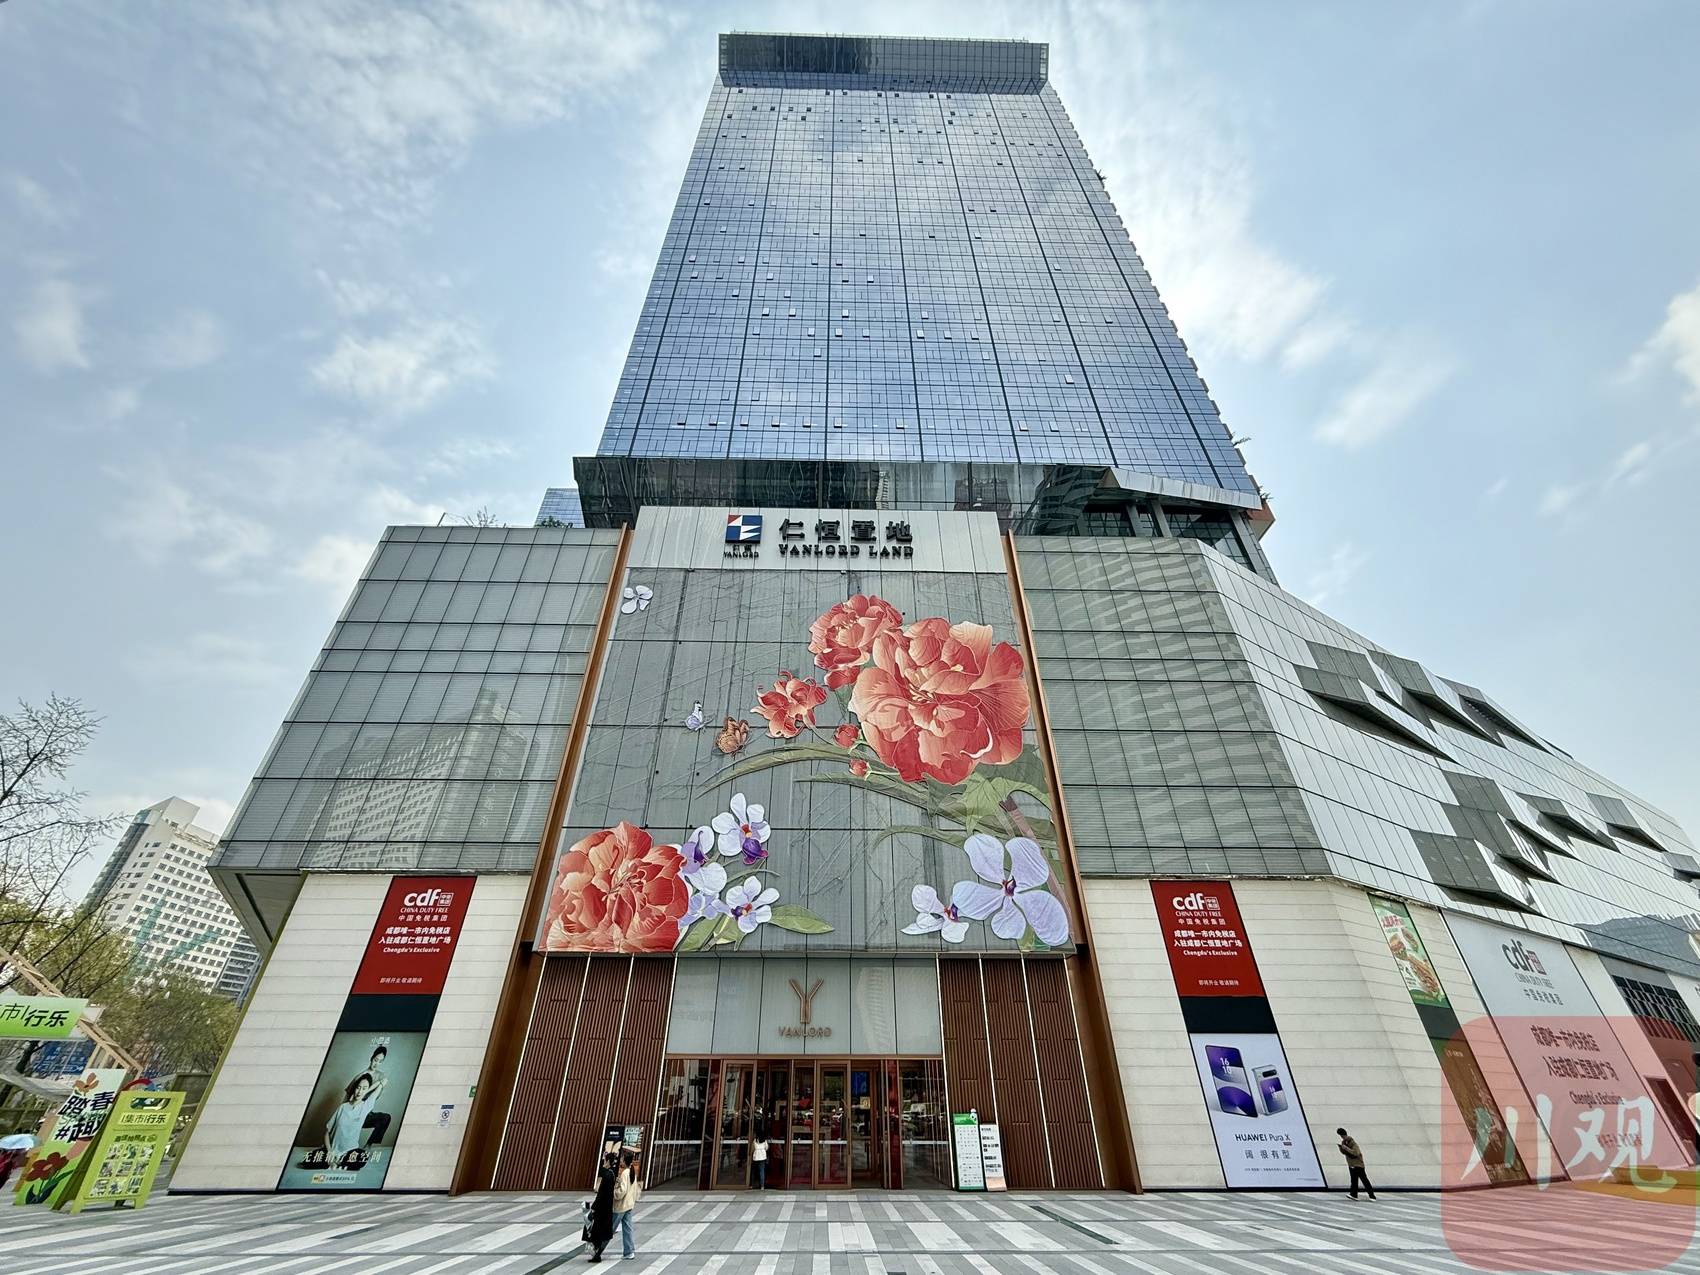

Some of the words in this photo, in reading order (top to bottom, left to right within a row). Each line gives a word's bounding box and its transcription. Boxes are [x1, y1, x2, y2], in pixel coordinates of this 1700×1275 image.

[779, 518, 913, 542] 仁恒置地
[723, 551, 760, 559] YANLORD
[778, 543, 860, 558] YANLORD
[868, 544, 914, 560] LAND
[403, 888, 442, 907] cdf
[1172, 892, 1205, 910] cdf
[1501, 938, 1535, 973] cdf
[1234, 1133, 1268, 1142] HUAWEI
[1268, 1133, 1284, 1142] Pura
